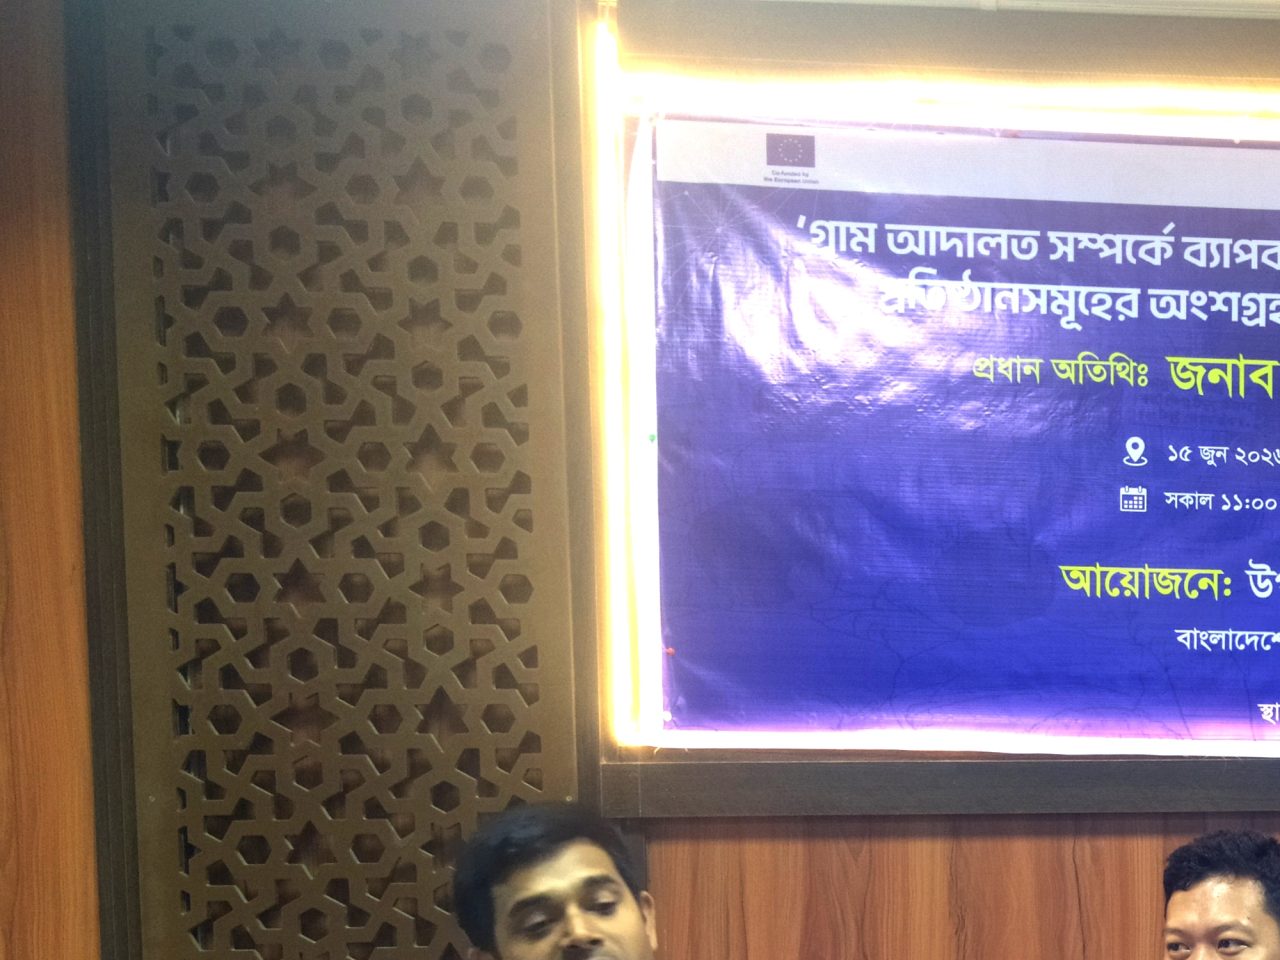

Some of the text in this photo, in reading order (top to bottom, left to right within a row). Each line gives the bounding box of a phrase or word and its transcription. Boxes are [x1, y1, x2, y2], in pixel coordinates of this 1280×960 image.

[886, 223, 1041, 261] আদালত
[1047, 222, 1174, 266] সম্পর্কে
[880, 267, 1141, 331] প্রতিষ্ঠানসমূহের
[973, 355, 1044, 384] প্রধান
[1165, 354, 1280, 399] জনাব
[1168, 444, 1192, 462] ১৫
[1198, 445, 1229, 466] জুন
[1164, 491, 1213, 510] সকাল
